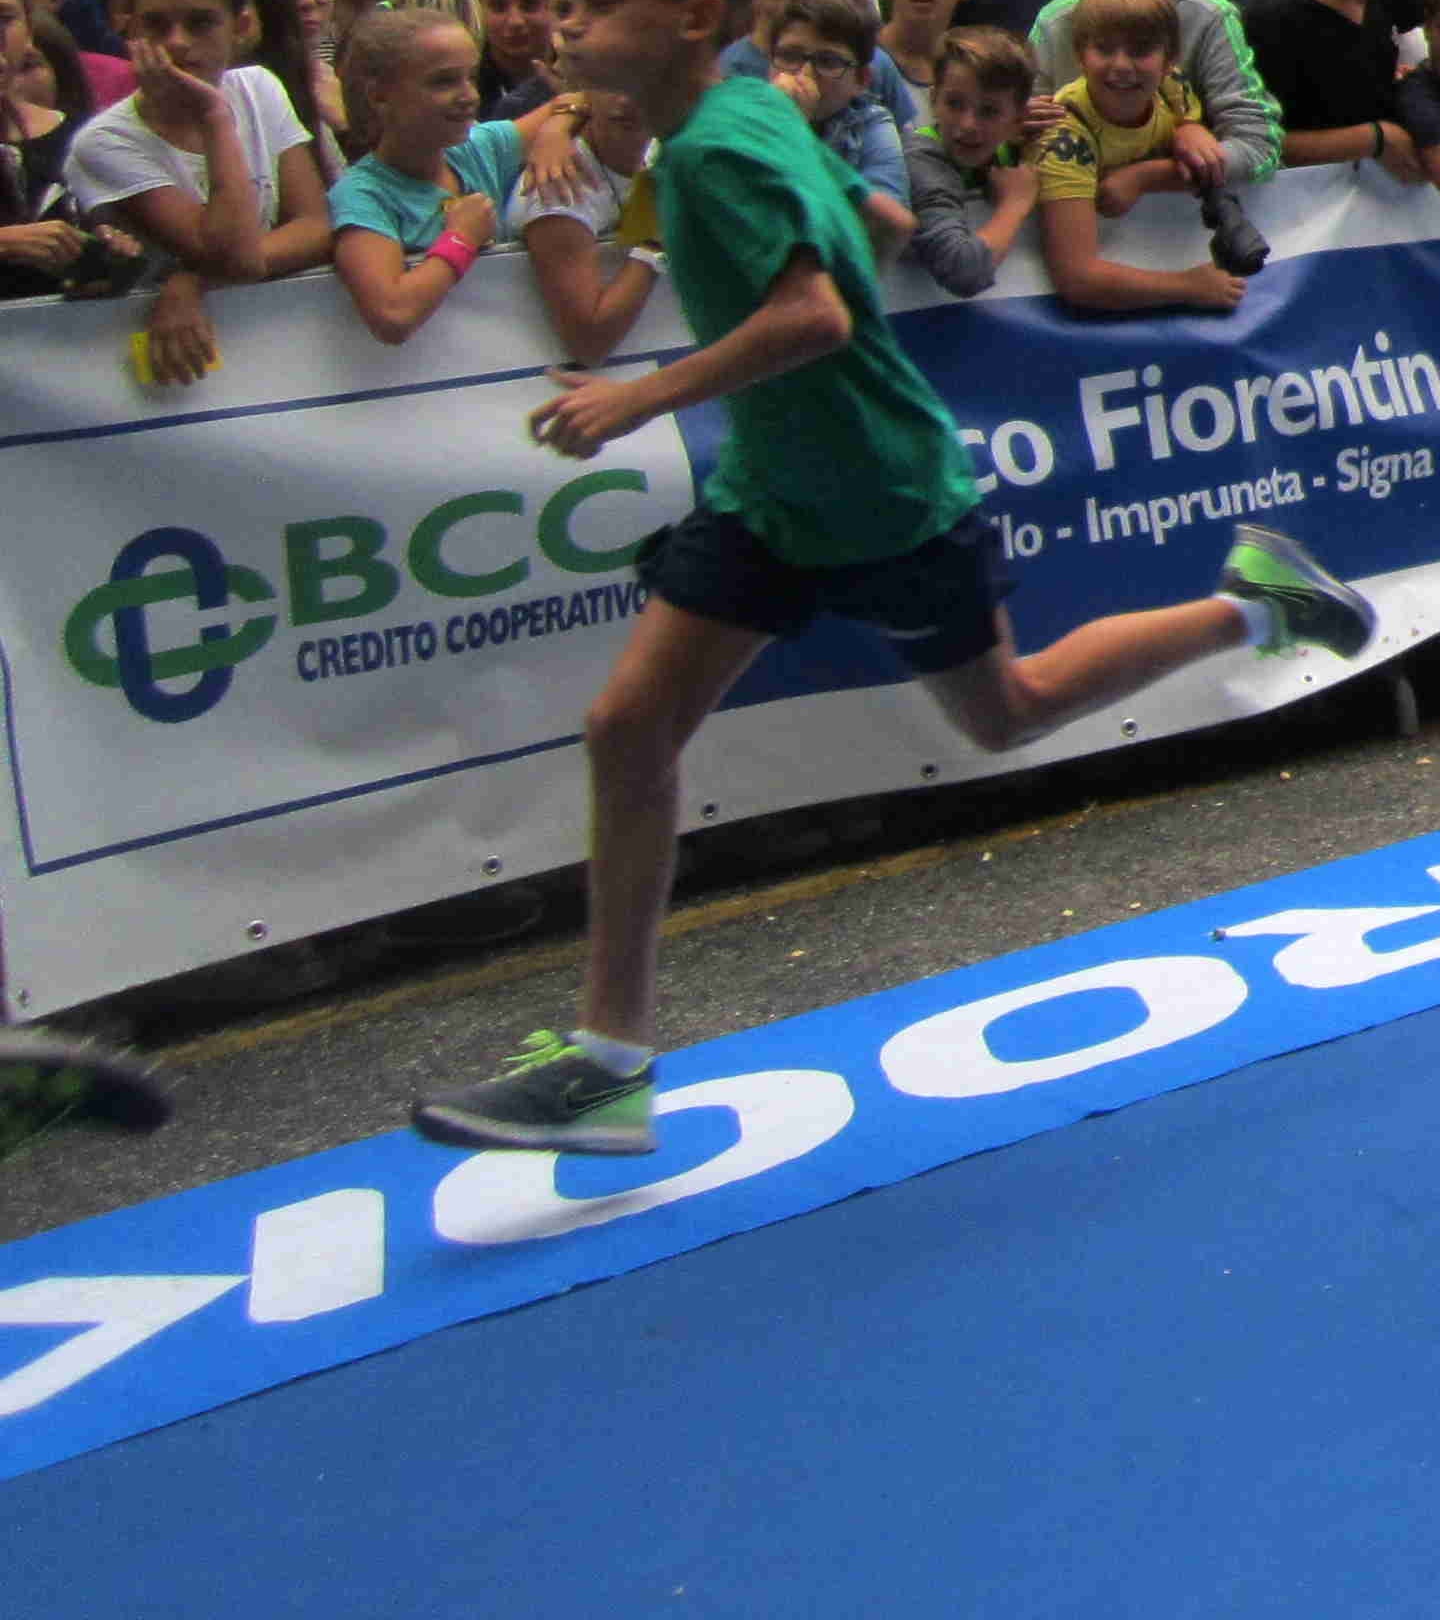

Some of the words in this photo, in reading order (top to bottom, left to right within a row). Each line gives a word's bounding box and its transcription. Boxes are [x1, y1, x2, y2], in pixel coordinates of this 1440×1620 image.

[1084, 466, 1305, 545] Impruneta
[1335, 445, 1435, 500] Signa
[283, 467, 649, 627] BCC
[297, 621, 437, 682] CREDITO
[445, 581, 650, 655] COOPERATIVO
